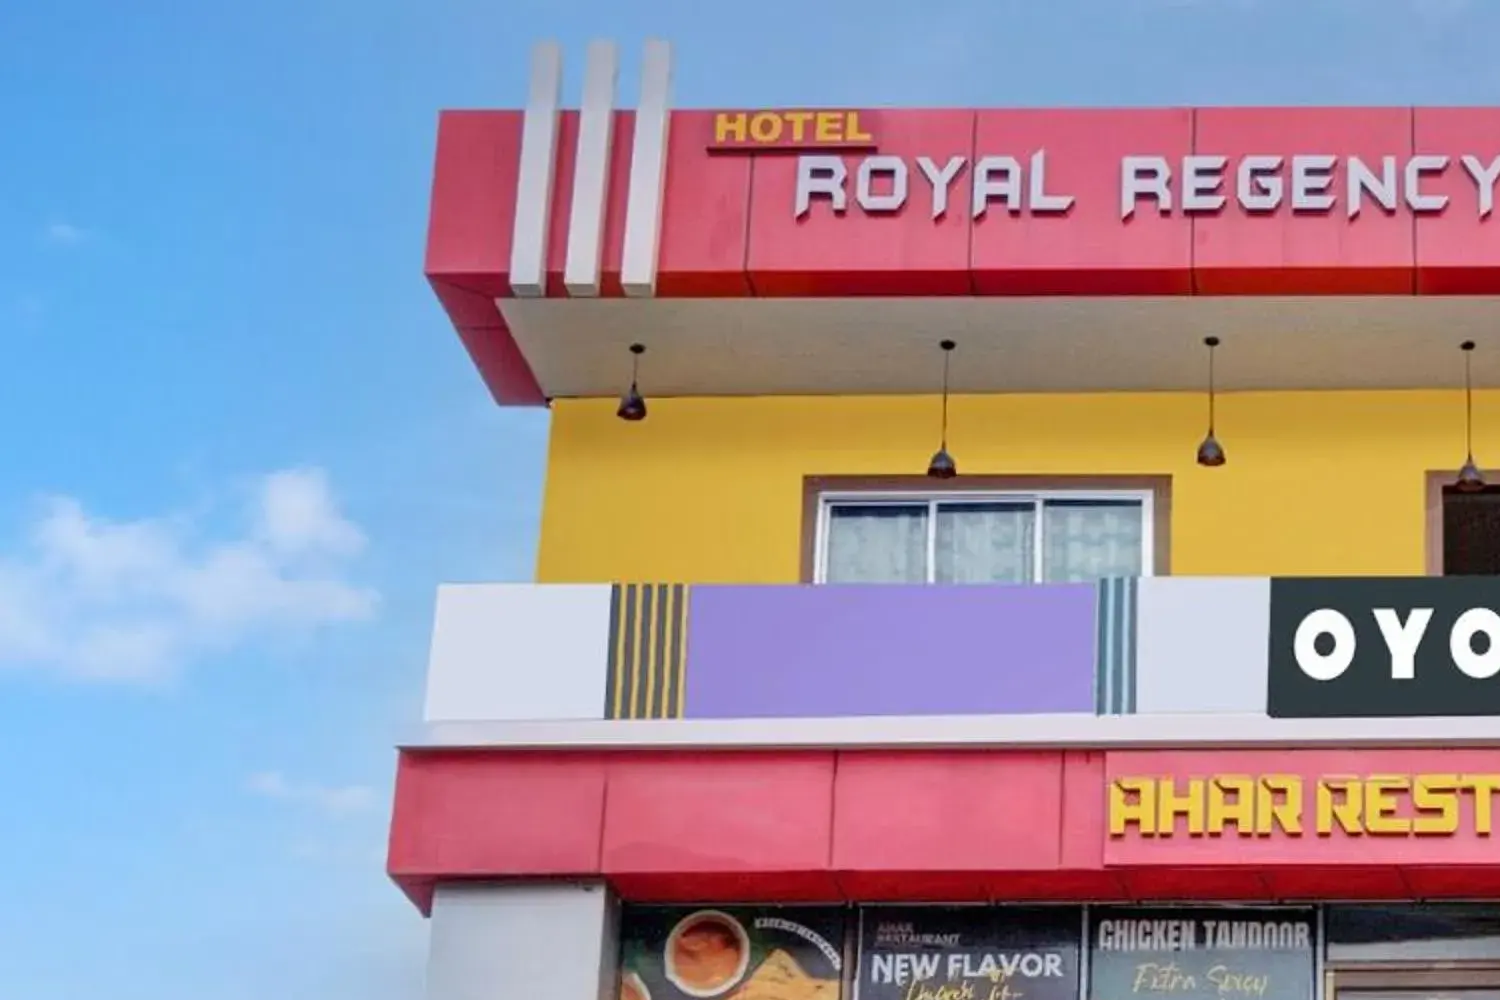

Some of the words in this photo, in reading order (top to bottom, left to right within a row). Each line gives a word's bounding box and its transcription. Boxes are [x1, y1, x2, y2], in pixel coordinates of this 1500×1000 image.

[715, 111, 872, 143] HOTEL
[794, 149, 1076, 221] ROYAL
[1109, 774, 1303, 838] AHAR
[1099, 919, 1196, 951] CHICKEN
[870, 953, 940, 986] NEW
[947, 953, 1064, 980] FLAVOR
